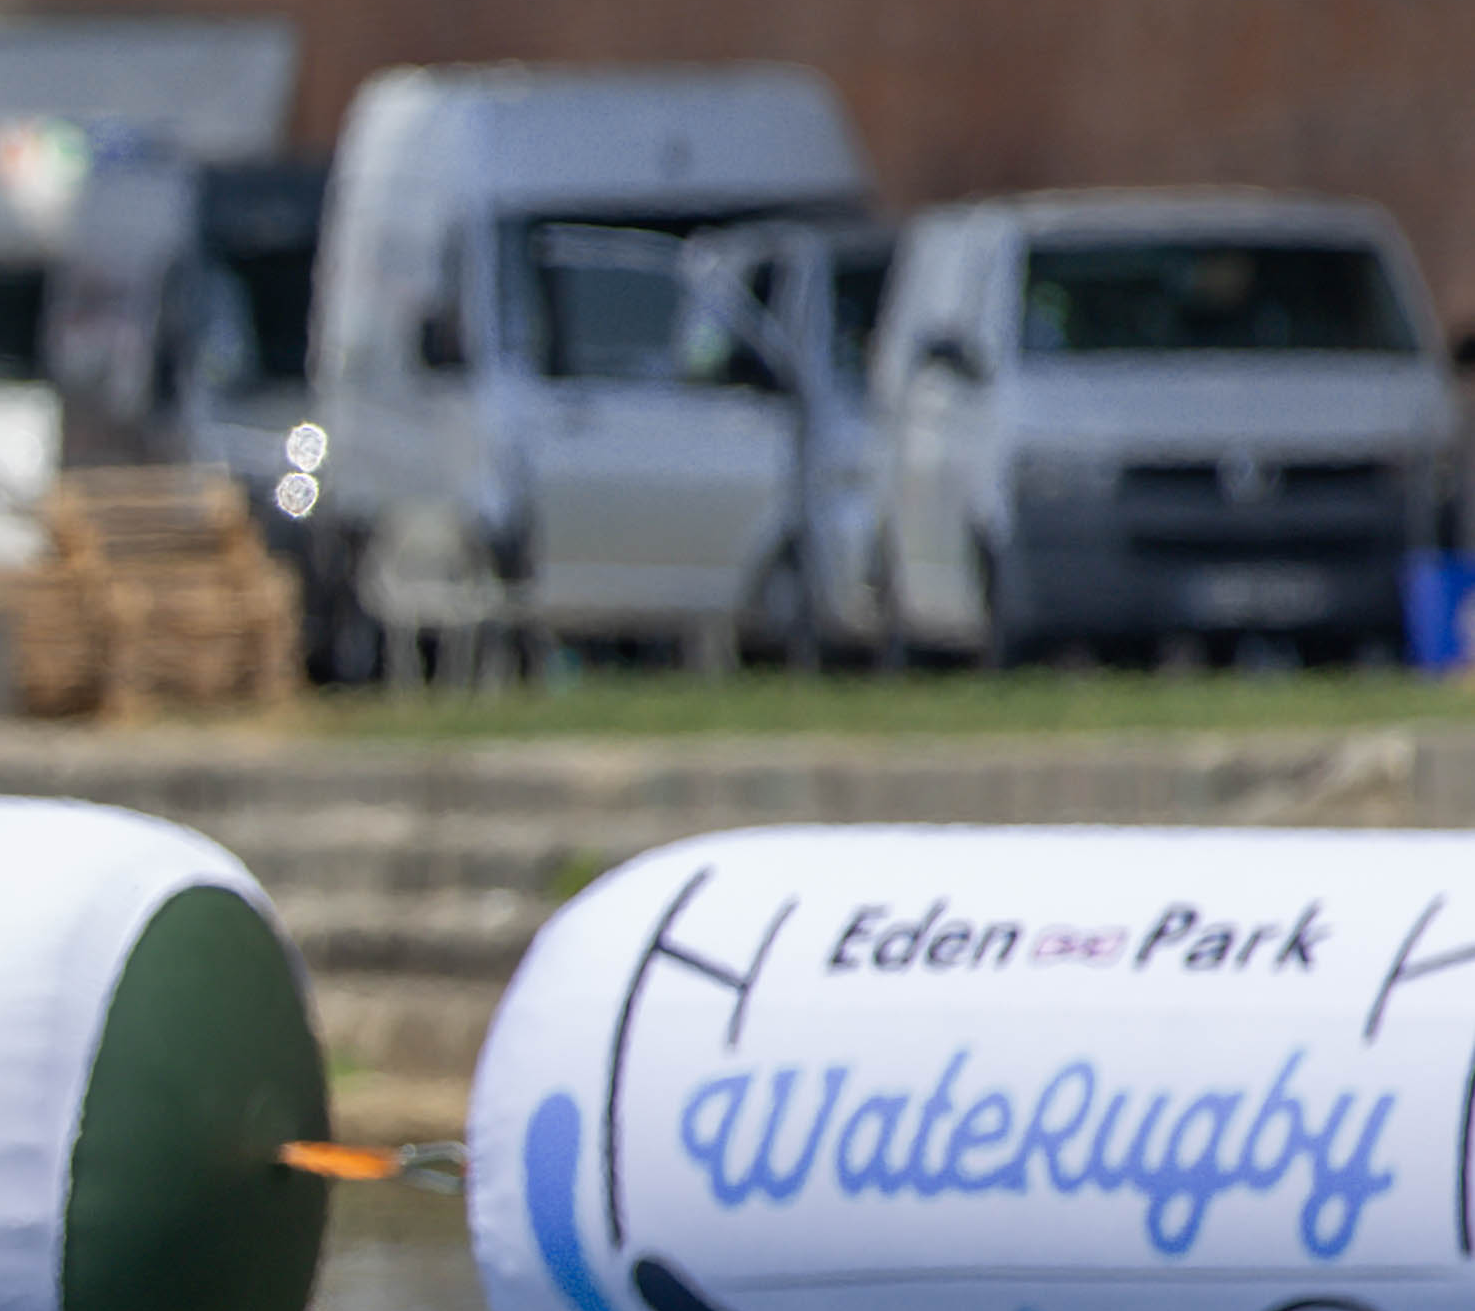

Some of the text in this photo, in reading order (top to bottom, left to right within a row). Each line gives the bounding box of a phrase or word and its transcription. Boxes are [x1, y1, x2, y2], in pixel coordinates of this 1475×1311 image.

[826, 897, 1335, 973] Eden Park
[679, 1047, 1398, 1262] WateRugby
